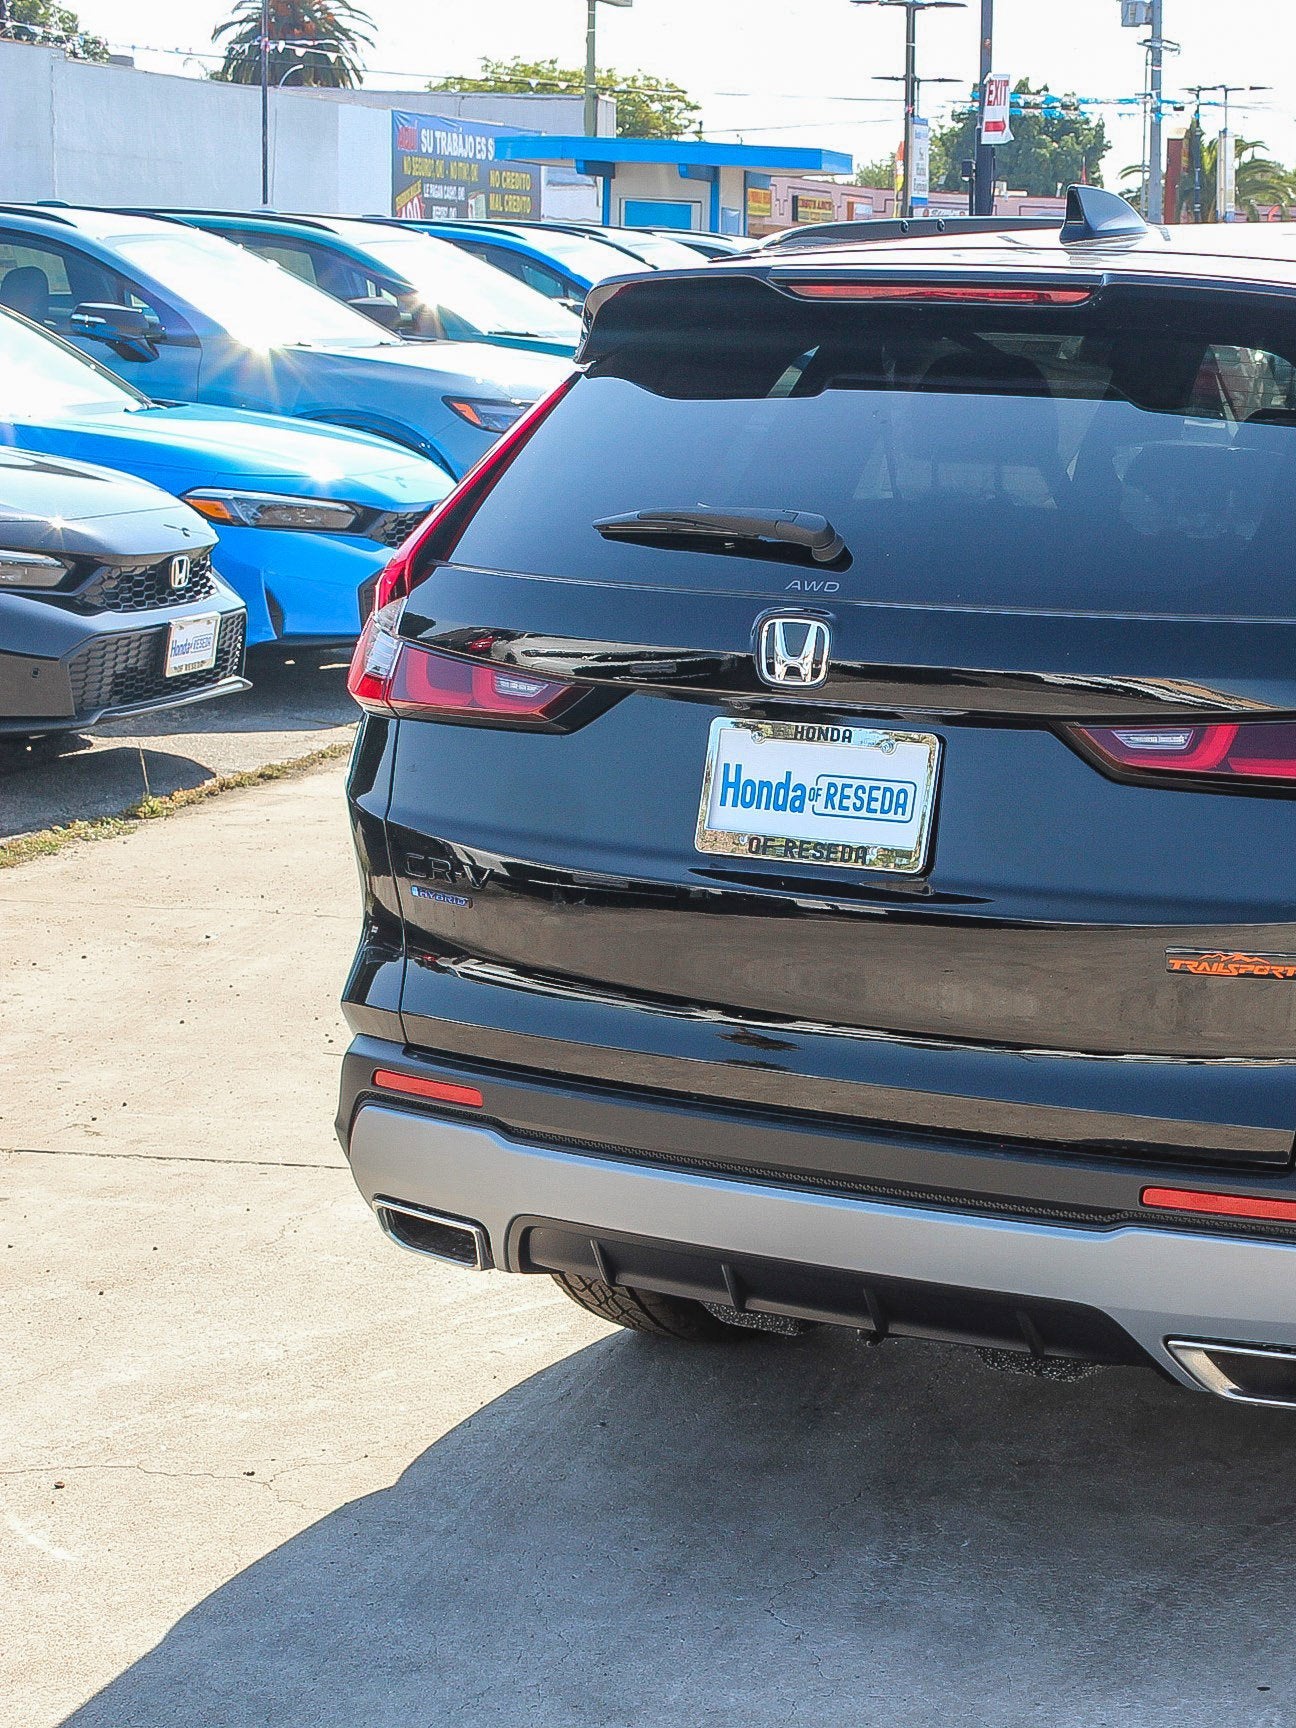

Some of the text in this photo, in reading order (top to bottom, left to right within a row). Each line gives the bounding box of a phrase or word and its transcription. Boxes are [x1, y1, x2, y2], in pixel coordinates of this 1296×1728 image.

[987, 79, 1009, 106] EXIT
[421, 128, 496, 161] SU TRABAJO ES S
[489, 169, 531, 191] NO CREDITO
[489, 193, 531, 214] MAL CREDITO
[784, 580, 840, 592] AWD
[794, 725, 853, 744] HONDA
[719, 762, 909, 817] Honda OF RESEDA
[748, 836, 868, 865] OF RESEDA
[404, 852, 495, 890] CR-V
[420, 891, 466, 906] HYBRID
